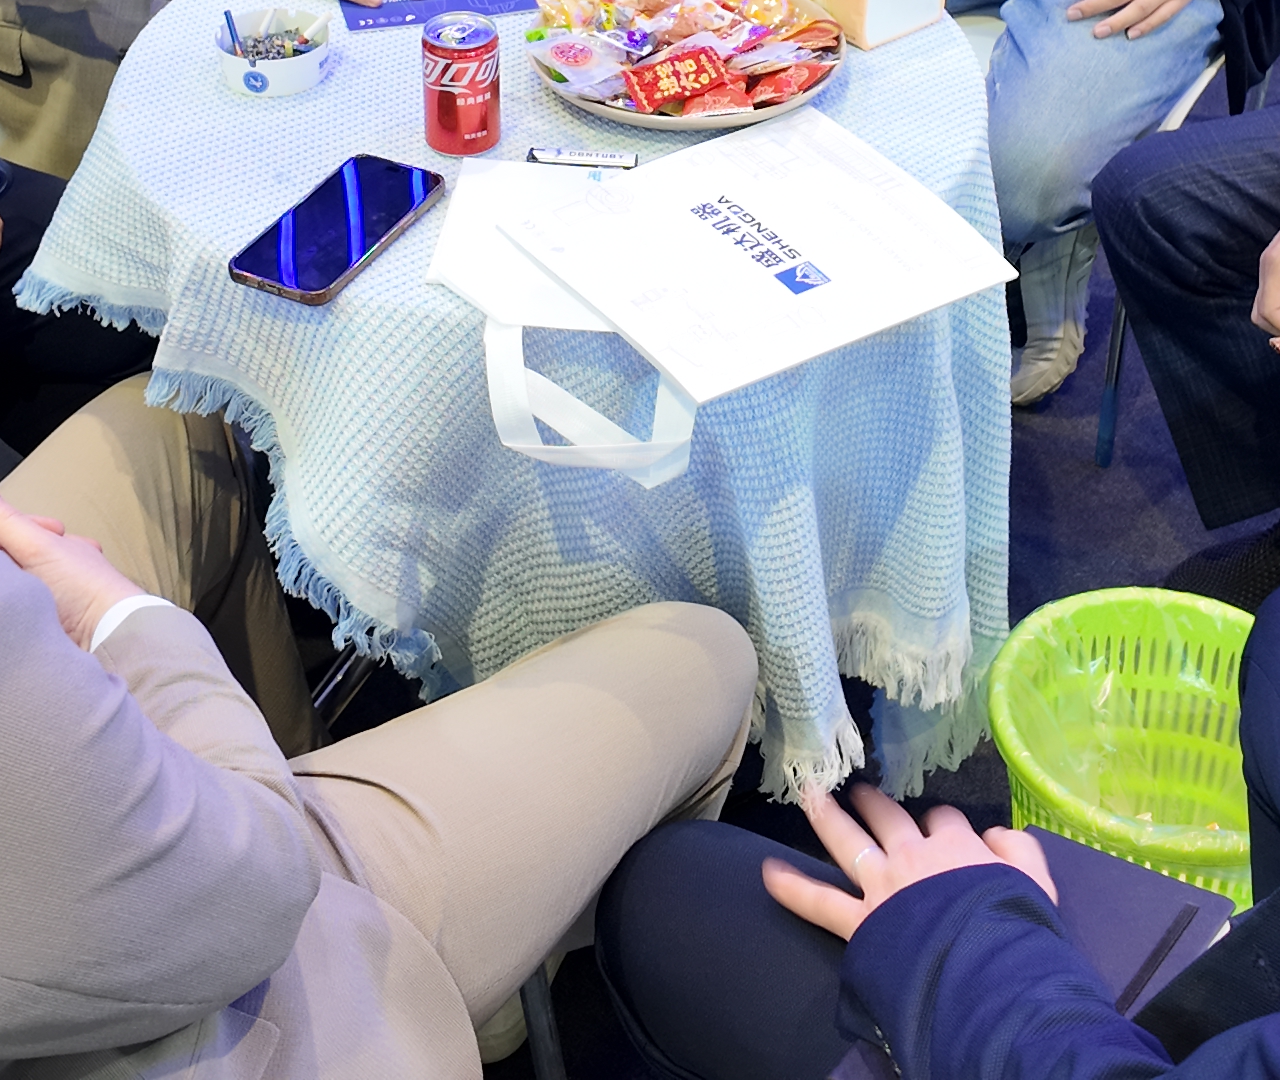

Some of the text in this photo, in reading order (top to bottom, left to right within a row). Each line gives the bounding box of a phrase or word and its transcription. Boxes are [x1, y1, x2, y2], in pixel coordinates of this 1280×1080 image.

[424, 47, 500, 91] 可口可
[690, 203, 786, 268] 盛达机器
[718, 195, 802, 260] SHENGDA
